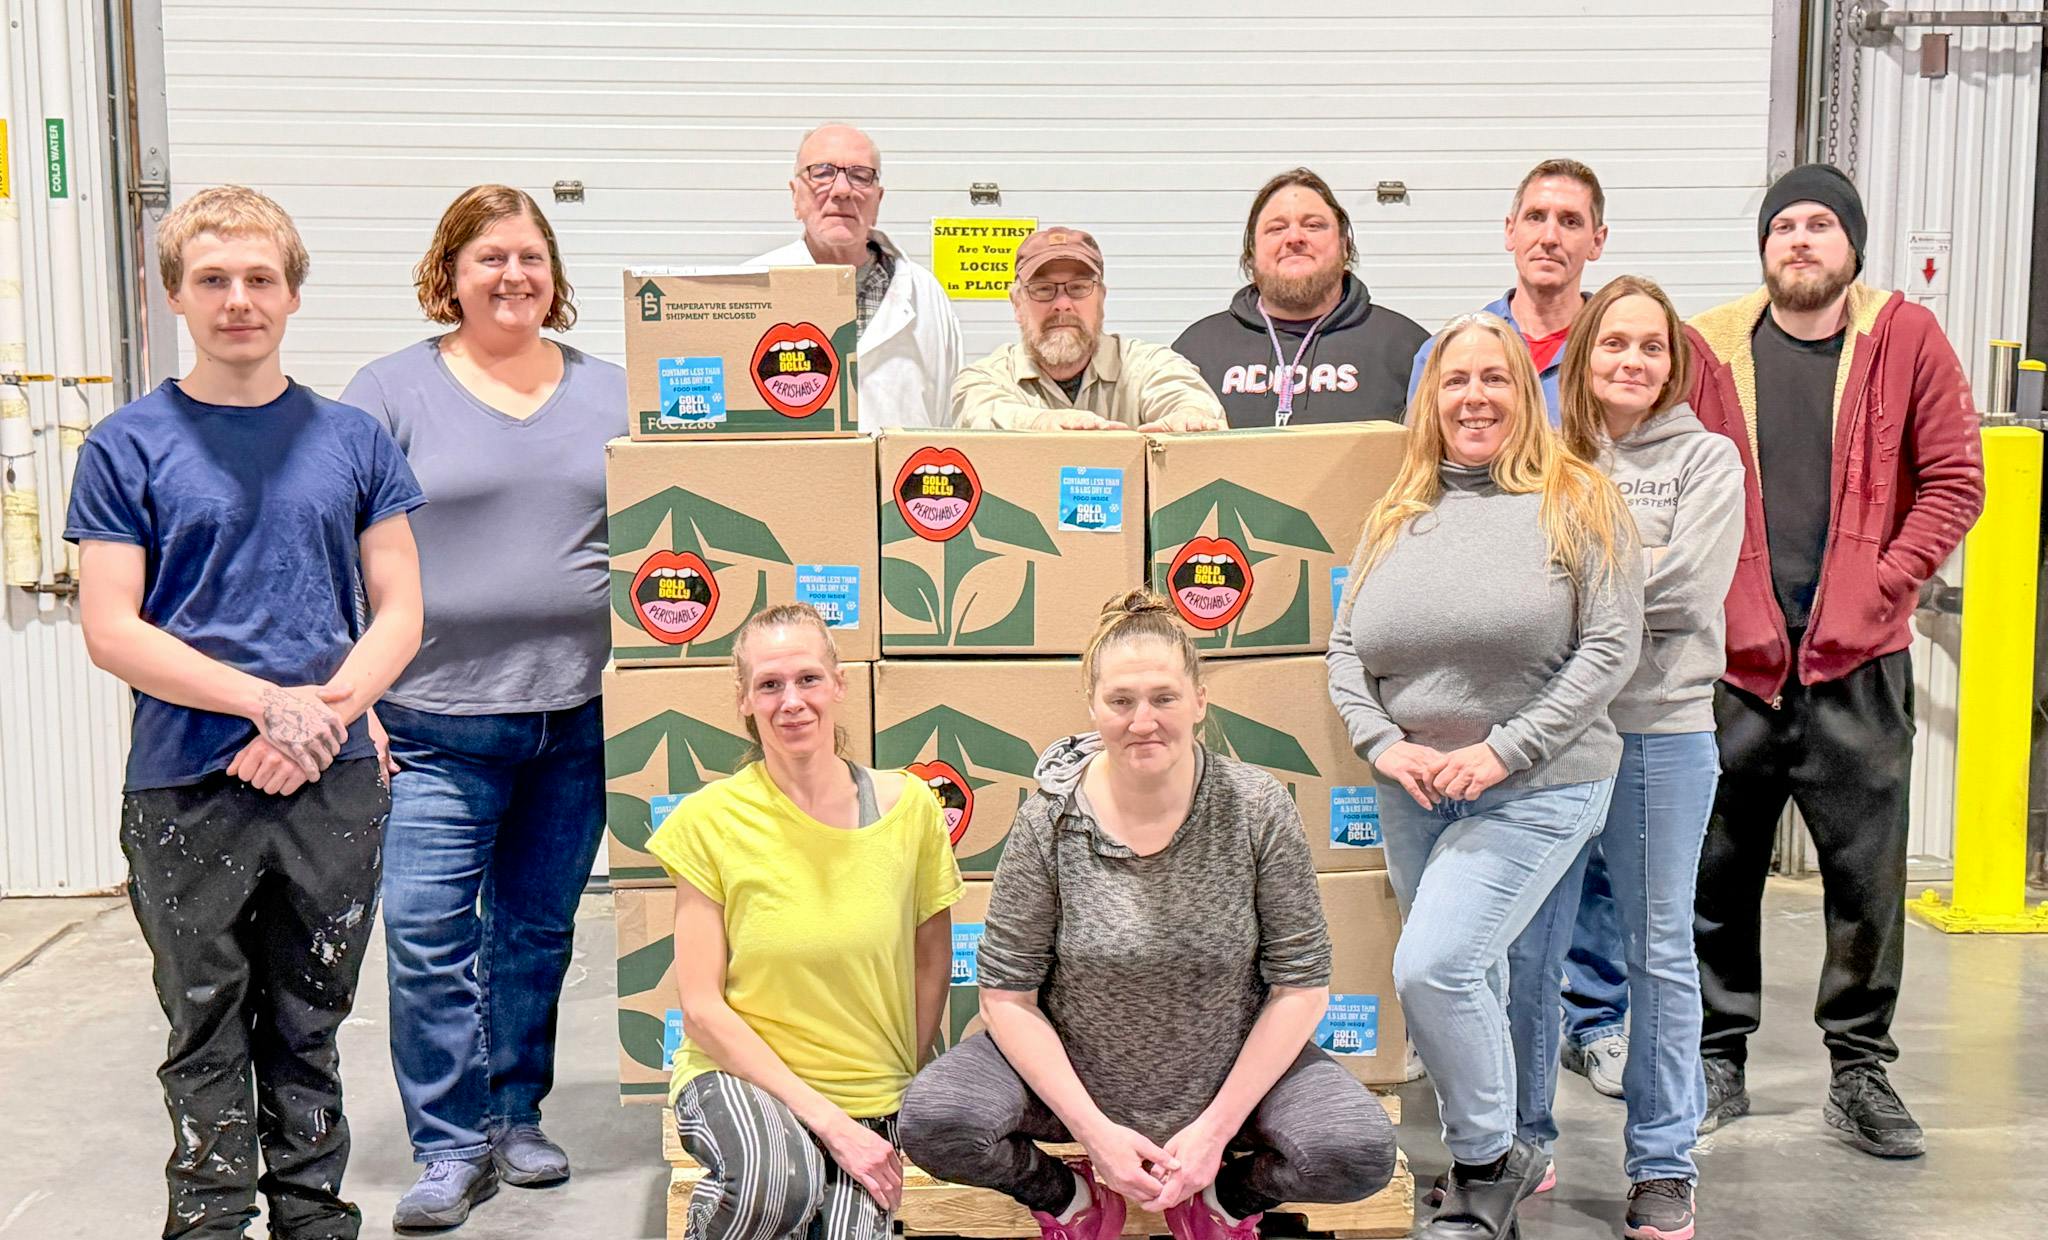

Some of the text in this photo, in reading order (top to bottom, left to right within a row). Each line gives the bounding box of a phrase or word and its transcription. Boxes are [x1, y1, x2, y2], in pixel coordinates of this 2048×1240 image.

[49, 125, 61, 192] COLD WATER
[934, 227, 1035, 236] SAFETY FIRST
[957, 245, 1012, 254] Are Your
[960, 262, 1008, 271] LOCKS
[948, 282, 960, 290] in
[644, 292, 658, 316] UP
[666, 302, 772, 310] TEMPERATURE SENSITIVE
[666, 312, 756, 320] SHIPMENT ENCLOSED
[779, 352, 804, 361] GOLD
[772, 378, 820, 398] PERISHABLE
[678, 395, 704, 405] GOLD
[922, 475, 948, 484] GOLD
[1627, 497, 1679, 508] SYSTEMS
[913, 502, 960, 522] PERISHABLE
[1077, 503, 1102, 513] GOLD
[1195, 565, 1221, 575] GOLD
[658, 578, 685, 589] GOLD
[1185, 591, 1232, 611] PERISHABLE
[814, 602, 838, 611] GOLD
[650, 605, 698, 625] PERISHABLE
[819, 610, 844, 621] ELLY
[1348, 821, 1372, 831] GOLD
[1333, 1030, 1358, 1039] GOLD
